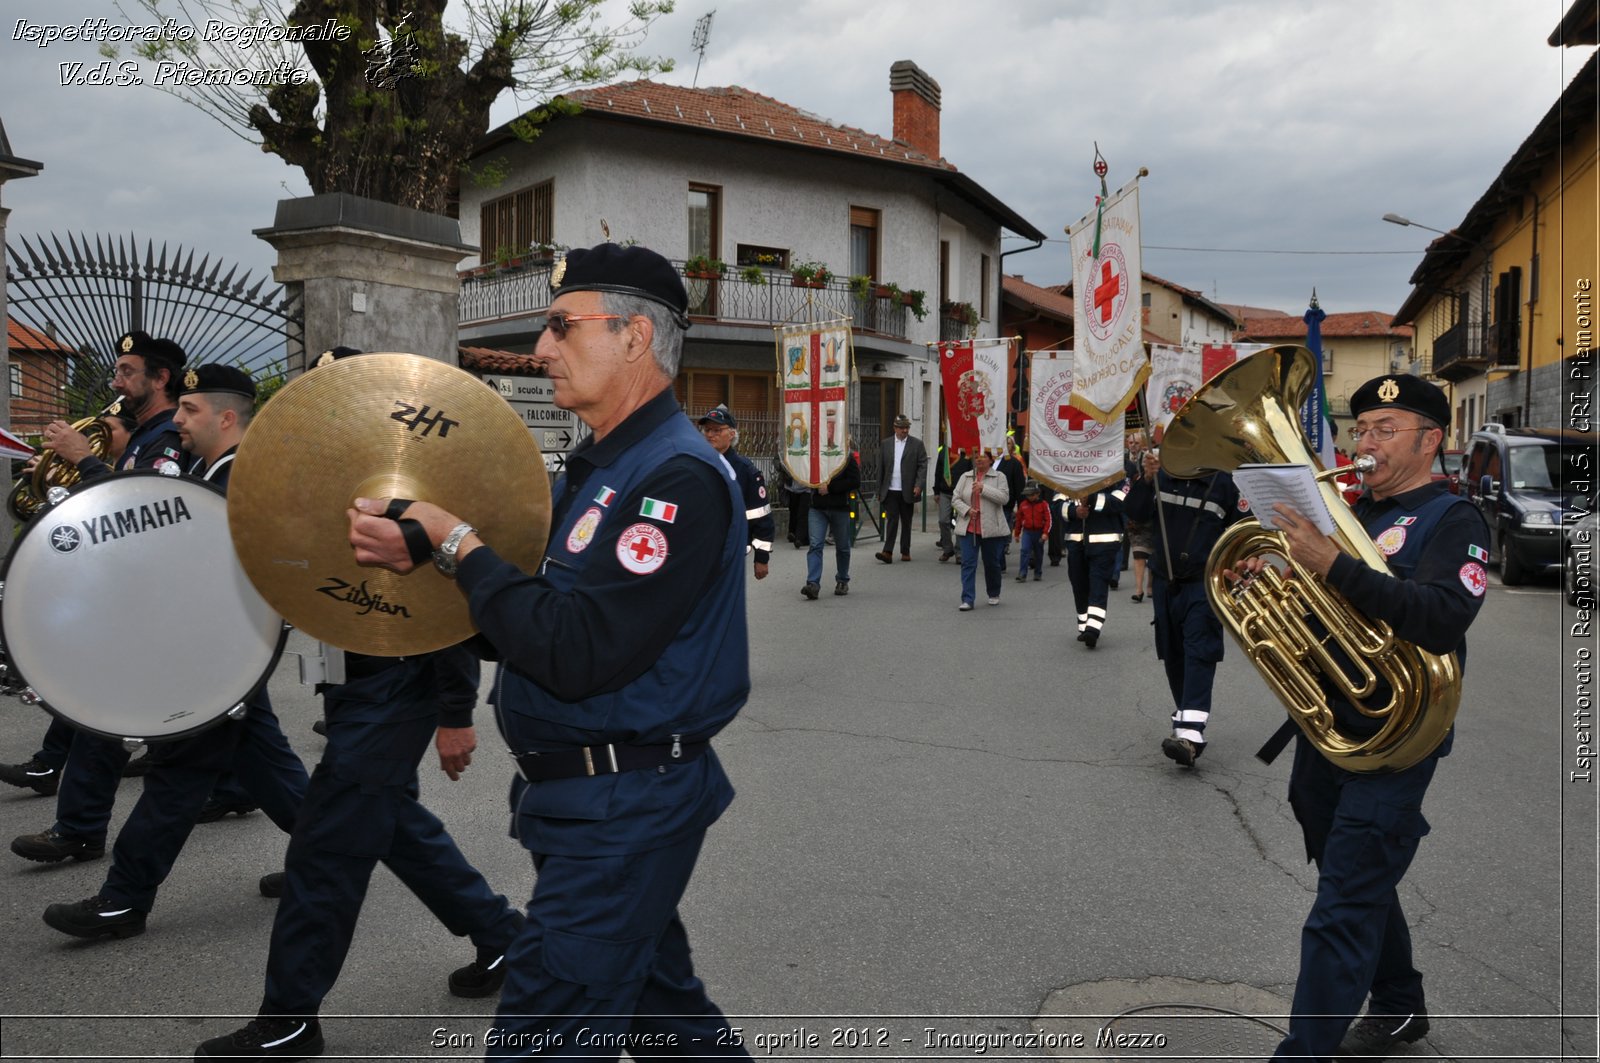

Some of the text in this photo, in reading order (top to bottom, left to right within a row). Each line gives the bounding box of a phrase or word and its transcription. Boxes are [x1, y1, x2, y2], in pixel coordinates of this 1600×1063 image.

[975, 353, 1000, 373] ANZIANI
[517, 386, 543, 395] scuola
[1036, 376, 1058, 403] CROCE
[390, 400, 460, 438] ZHT
[527, 409, 571, 421] FALCONIERI
[1036, 448, 1103, 458] DELEGAZIONE
[1052, 464, 1100, 473] GIAVENO
[81, 496, 192, 545] YAMAHA
[621, 525, 666, 559] CROCE ROSSA ITALIANA
[315, 577, 412, 618] Zildjian
